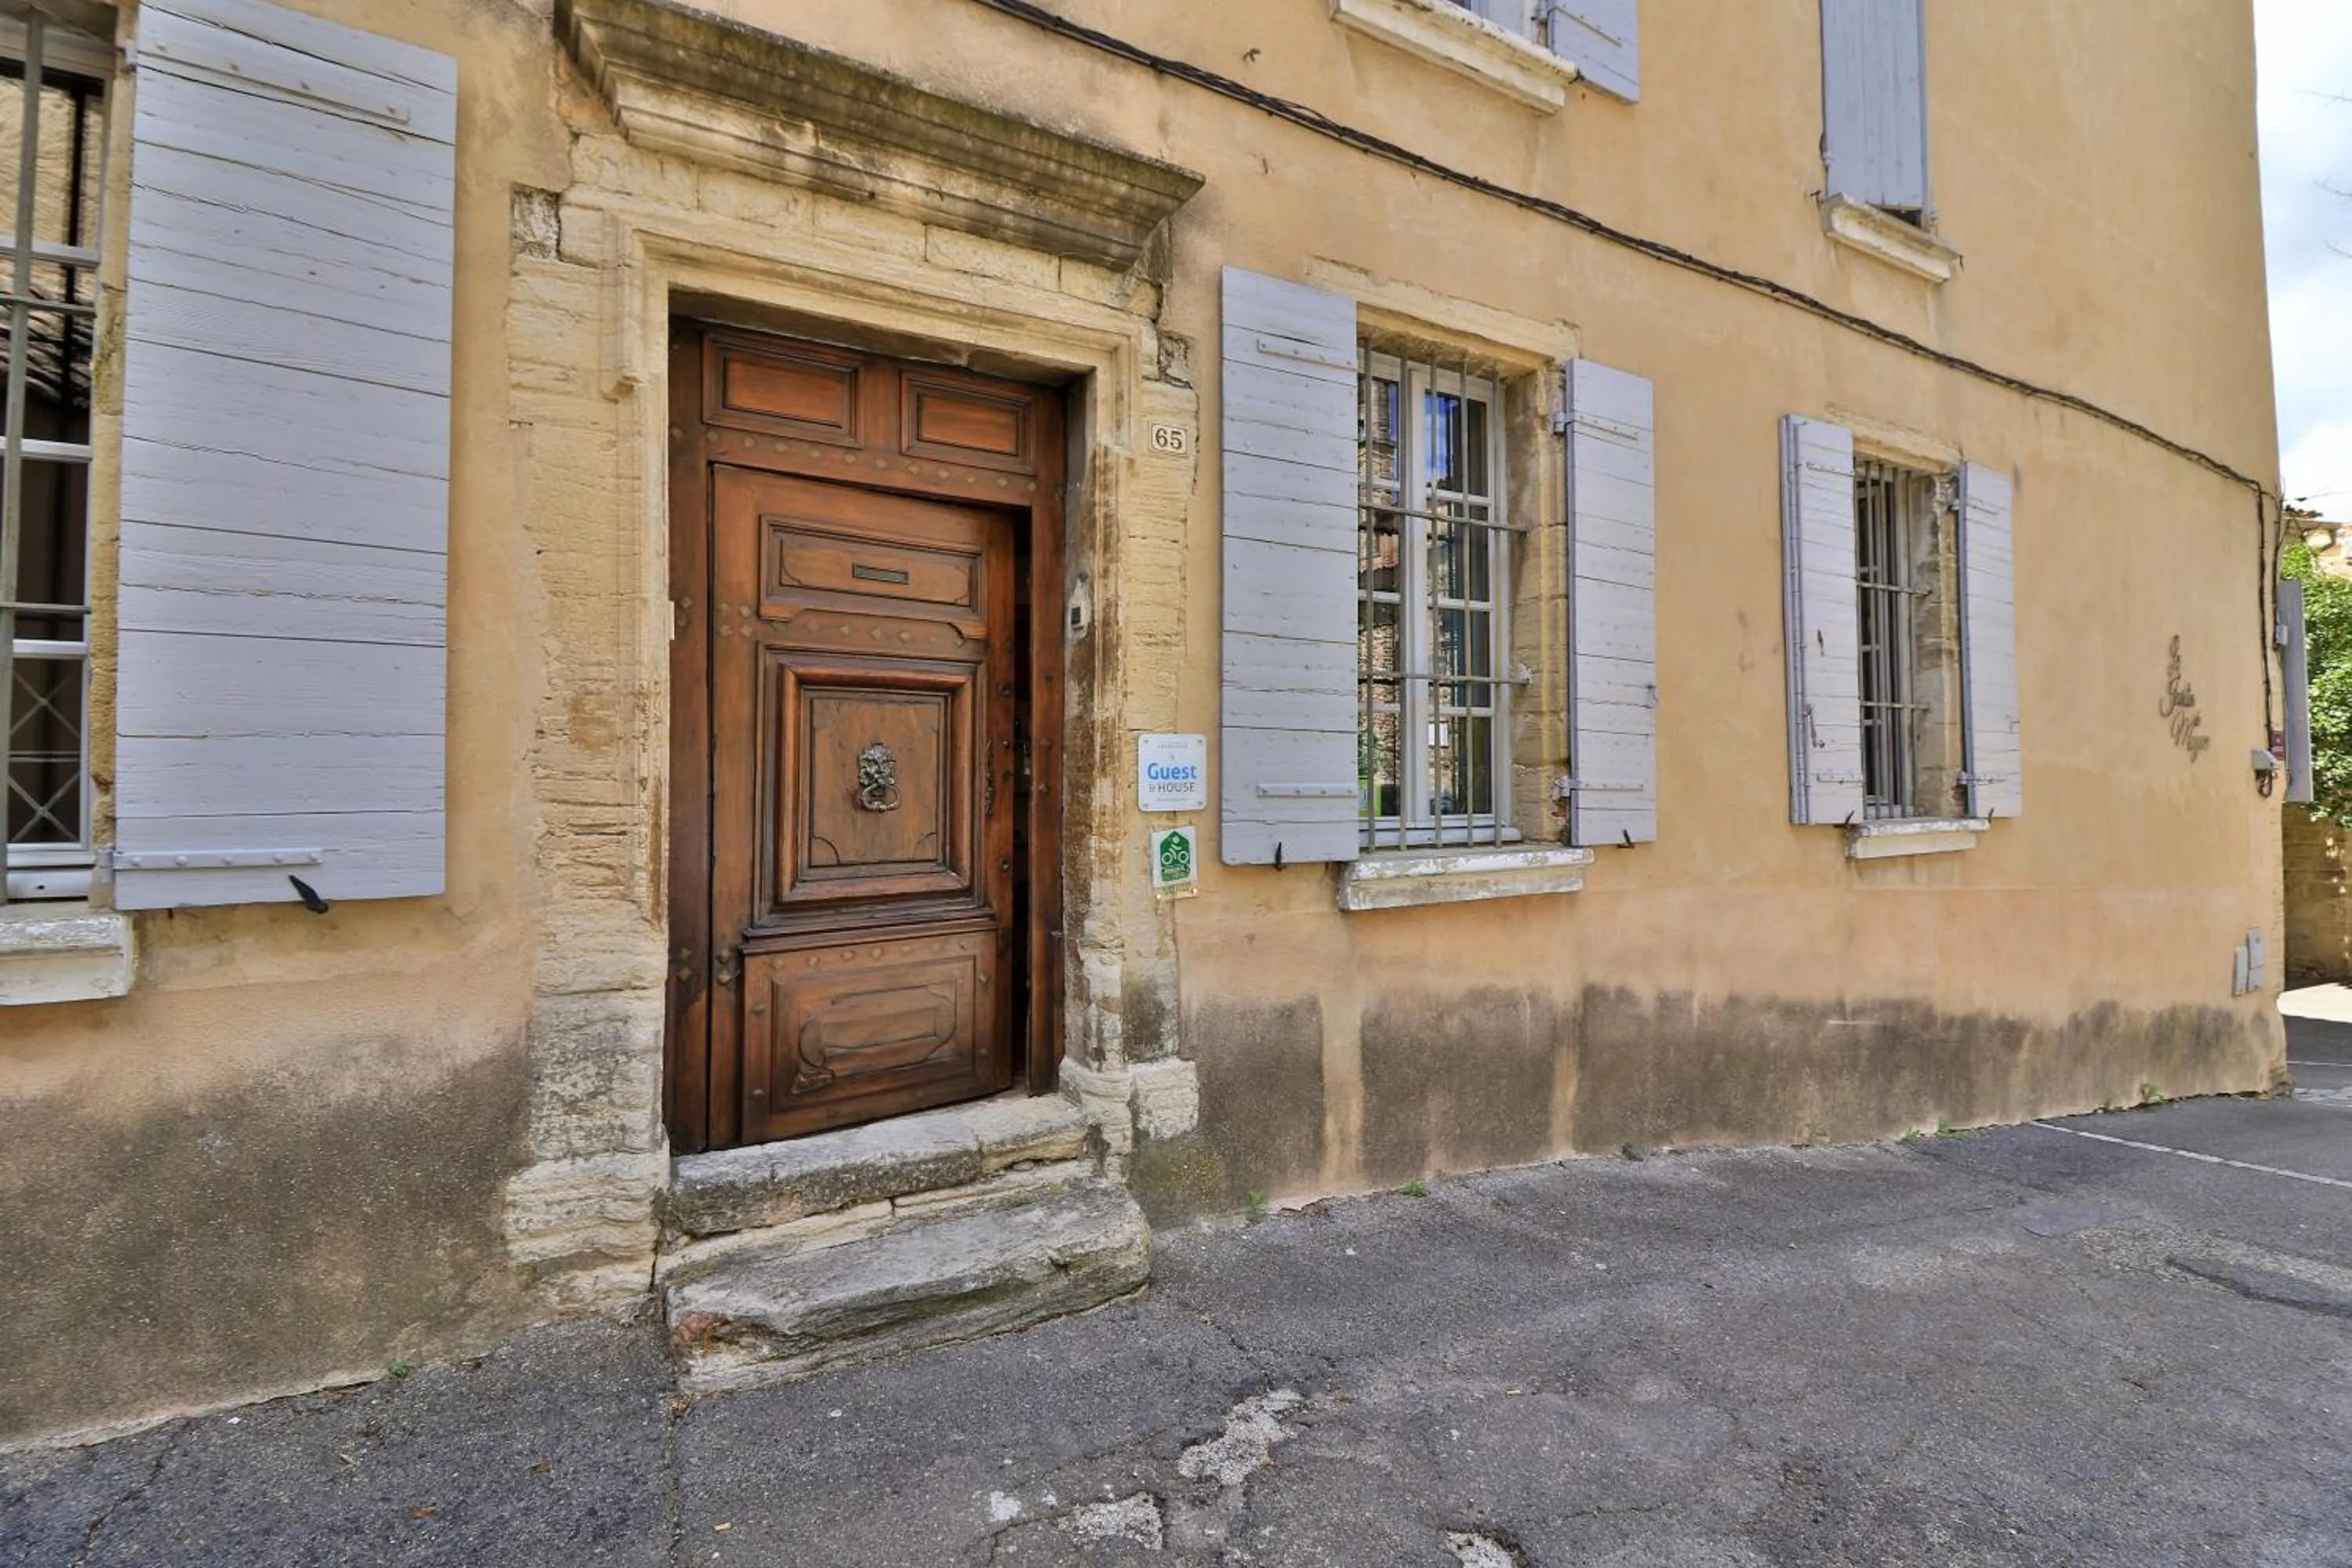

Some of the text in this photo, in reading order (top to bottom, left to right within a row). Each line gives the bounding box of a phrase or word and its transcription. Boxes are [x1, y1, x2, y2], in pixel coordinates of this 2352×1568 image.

[1156, 428, 1181, 450] 65
[1147, 762, 1197, 780] Guest
[1158, 782, 1196, 793] HOUSE
